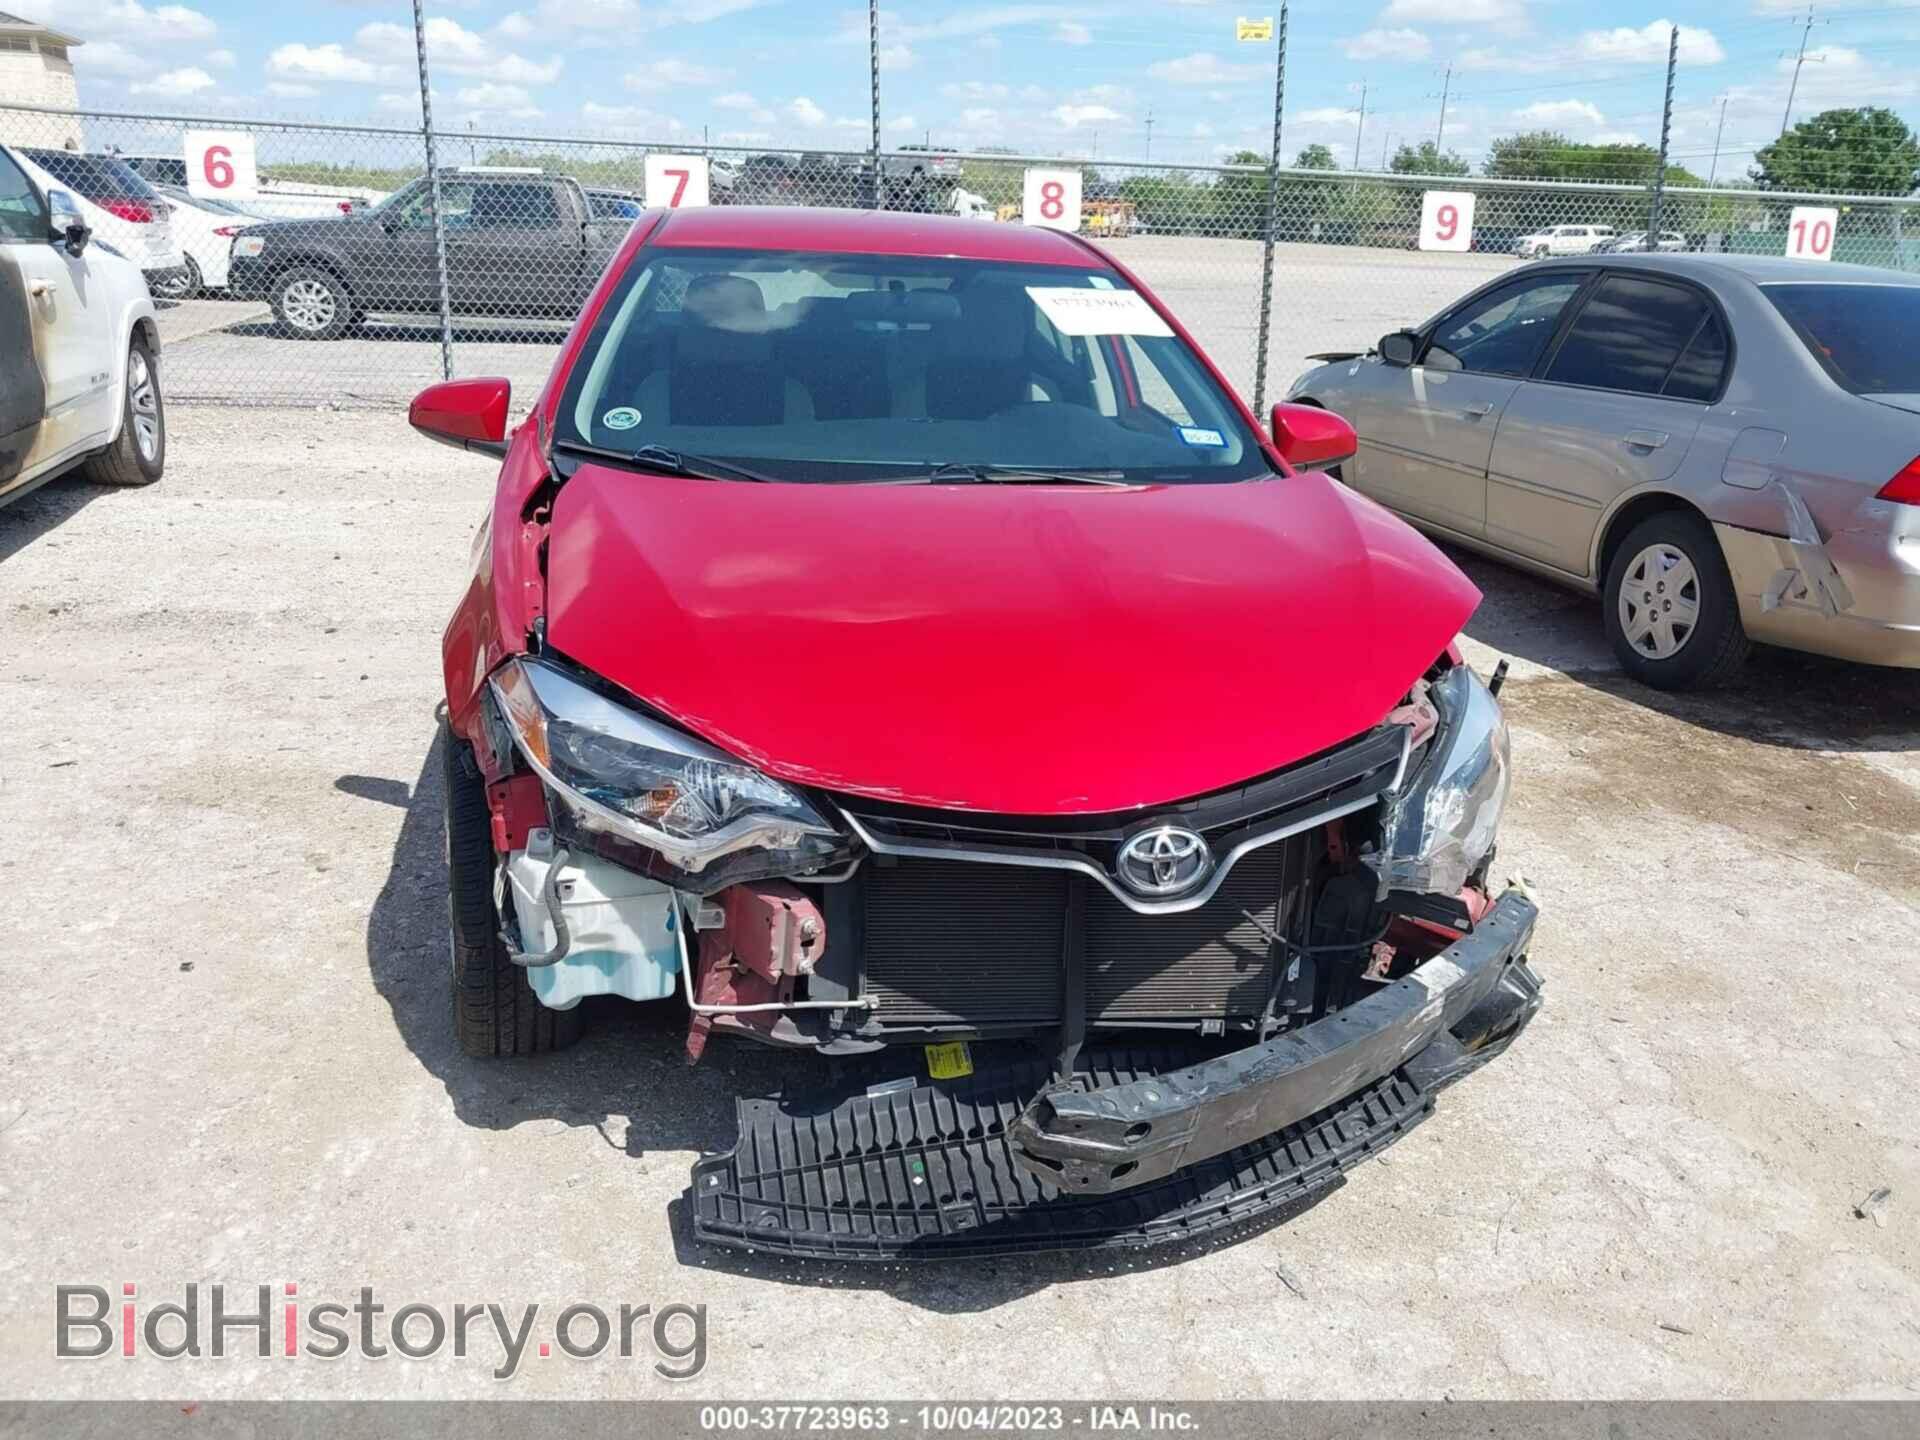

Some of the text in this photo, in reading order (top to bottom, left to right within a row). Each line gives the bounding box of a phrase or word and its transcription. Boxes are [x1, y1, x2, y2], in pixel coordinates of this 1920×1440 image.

[203, 146, 234, 189] 6
[663, 169, 690, 208] 7
[1039, 181, 1065, 220] 8
[1435, 204, 1459, 241] 9
[1792, 219, 1832, 255] 10
